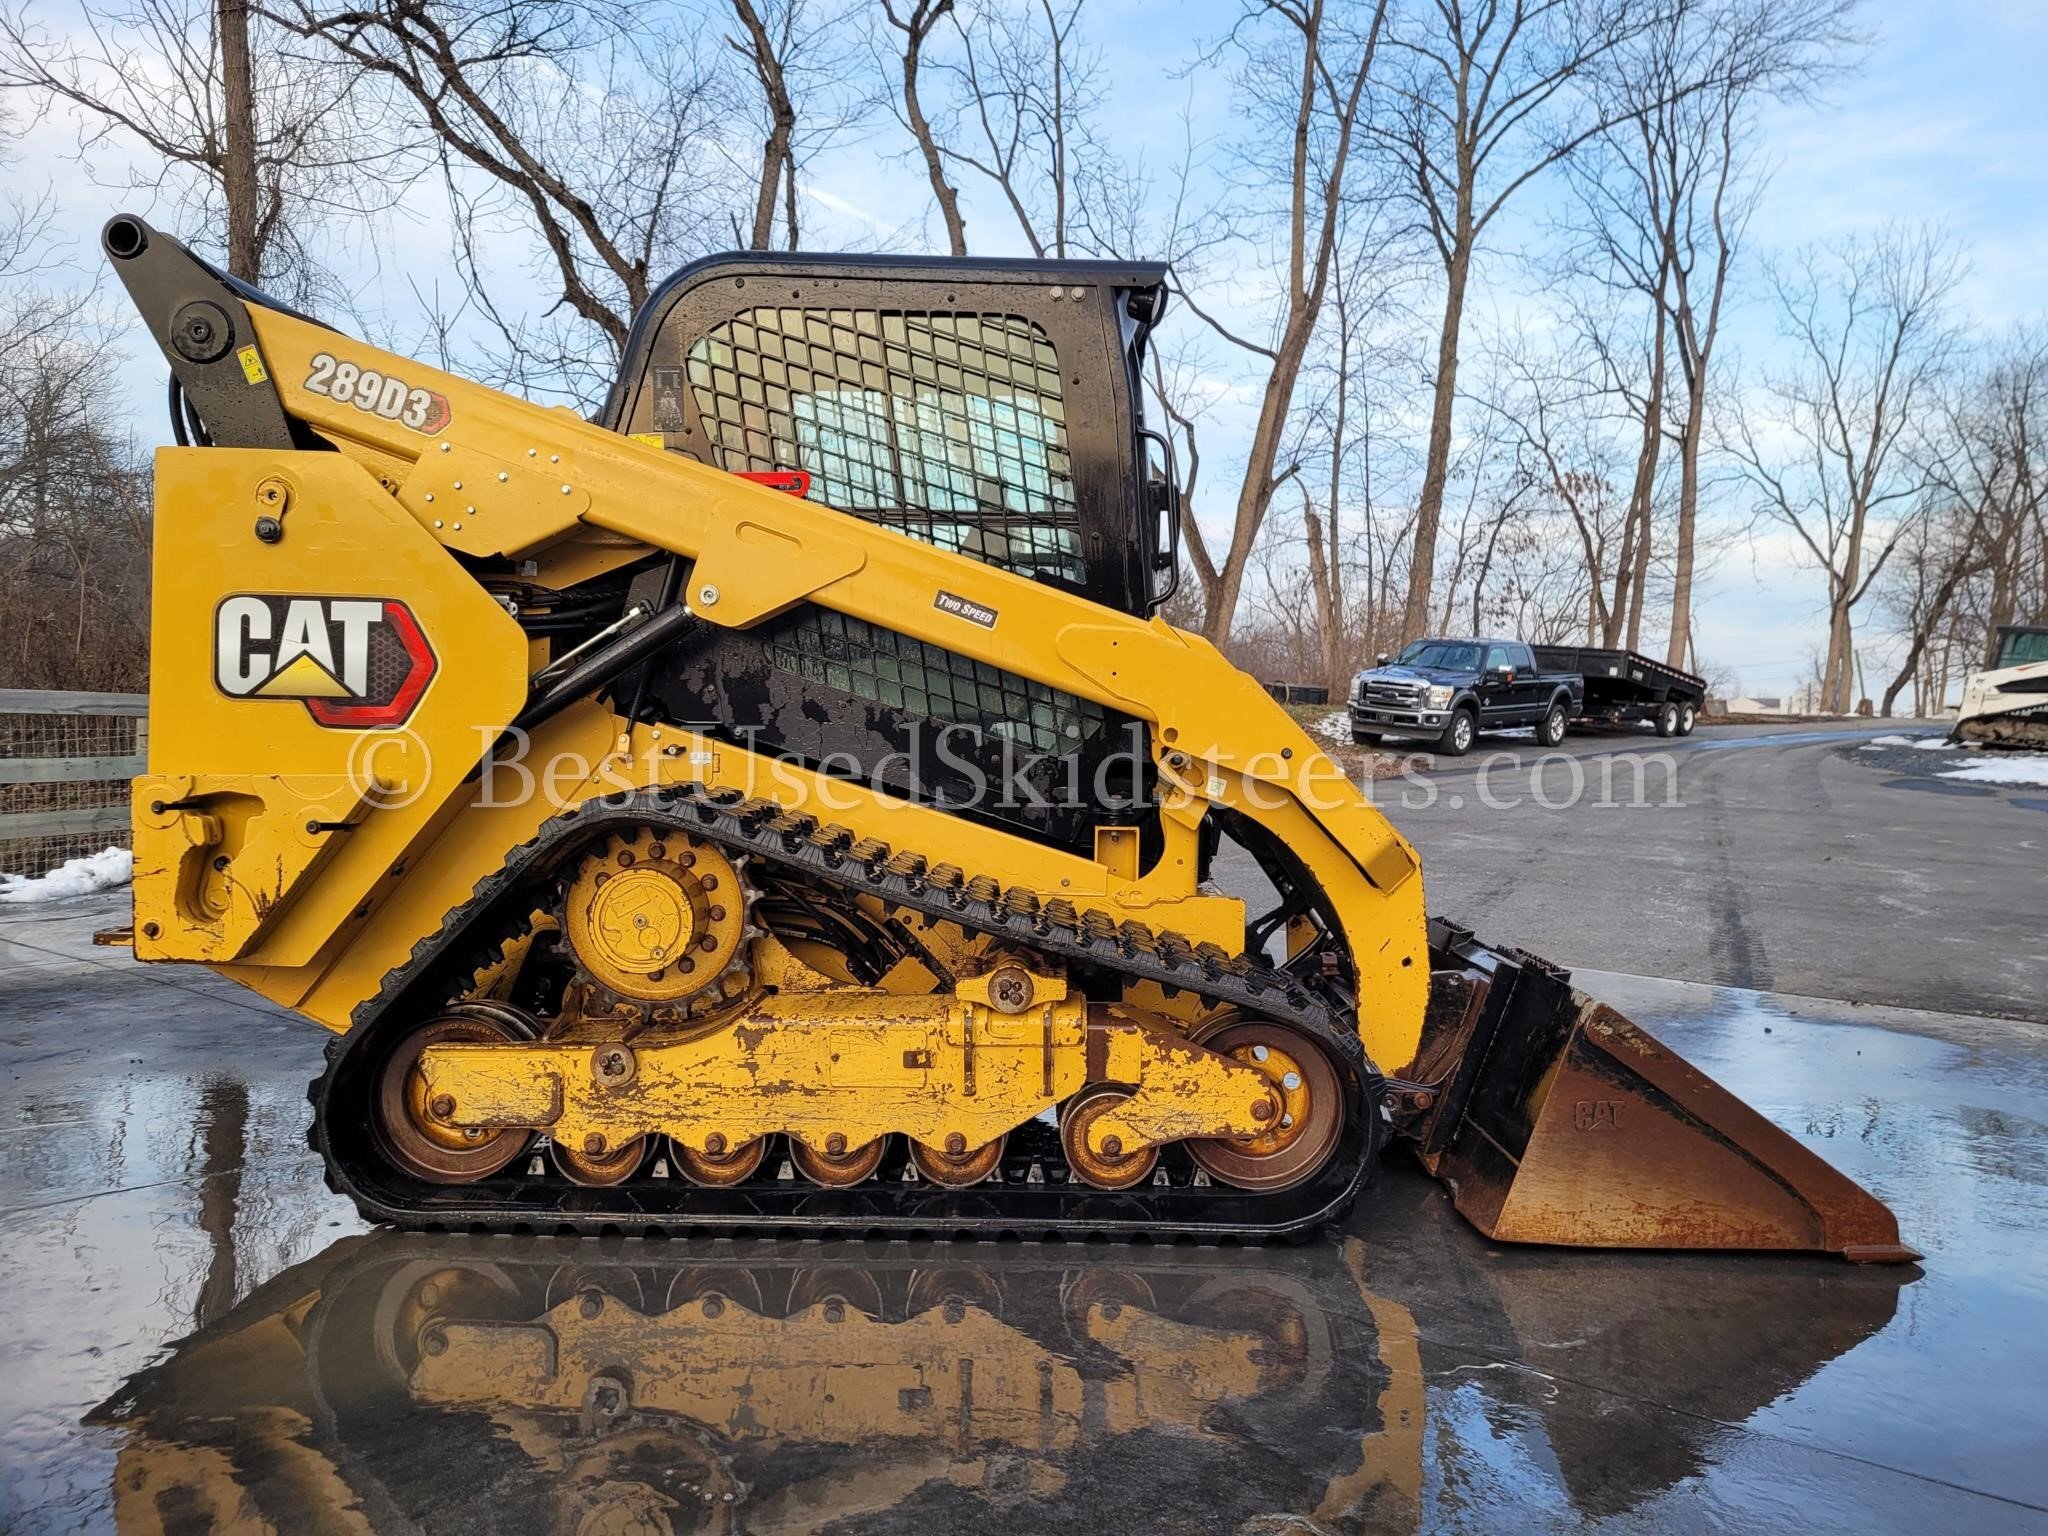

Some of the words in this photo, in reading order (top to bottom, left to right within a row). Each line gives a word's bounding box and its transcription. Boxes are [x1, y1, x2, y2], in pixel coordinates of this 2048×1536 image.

[304, 353, 432, 428] 289D3
[938, 594, 962, 611] TWO
[960, 604, 993, 623] SPEED
[218, 596, 383, 698] CAT
[1575, 1100, 1625, 1131] CAT
